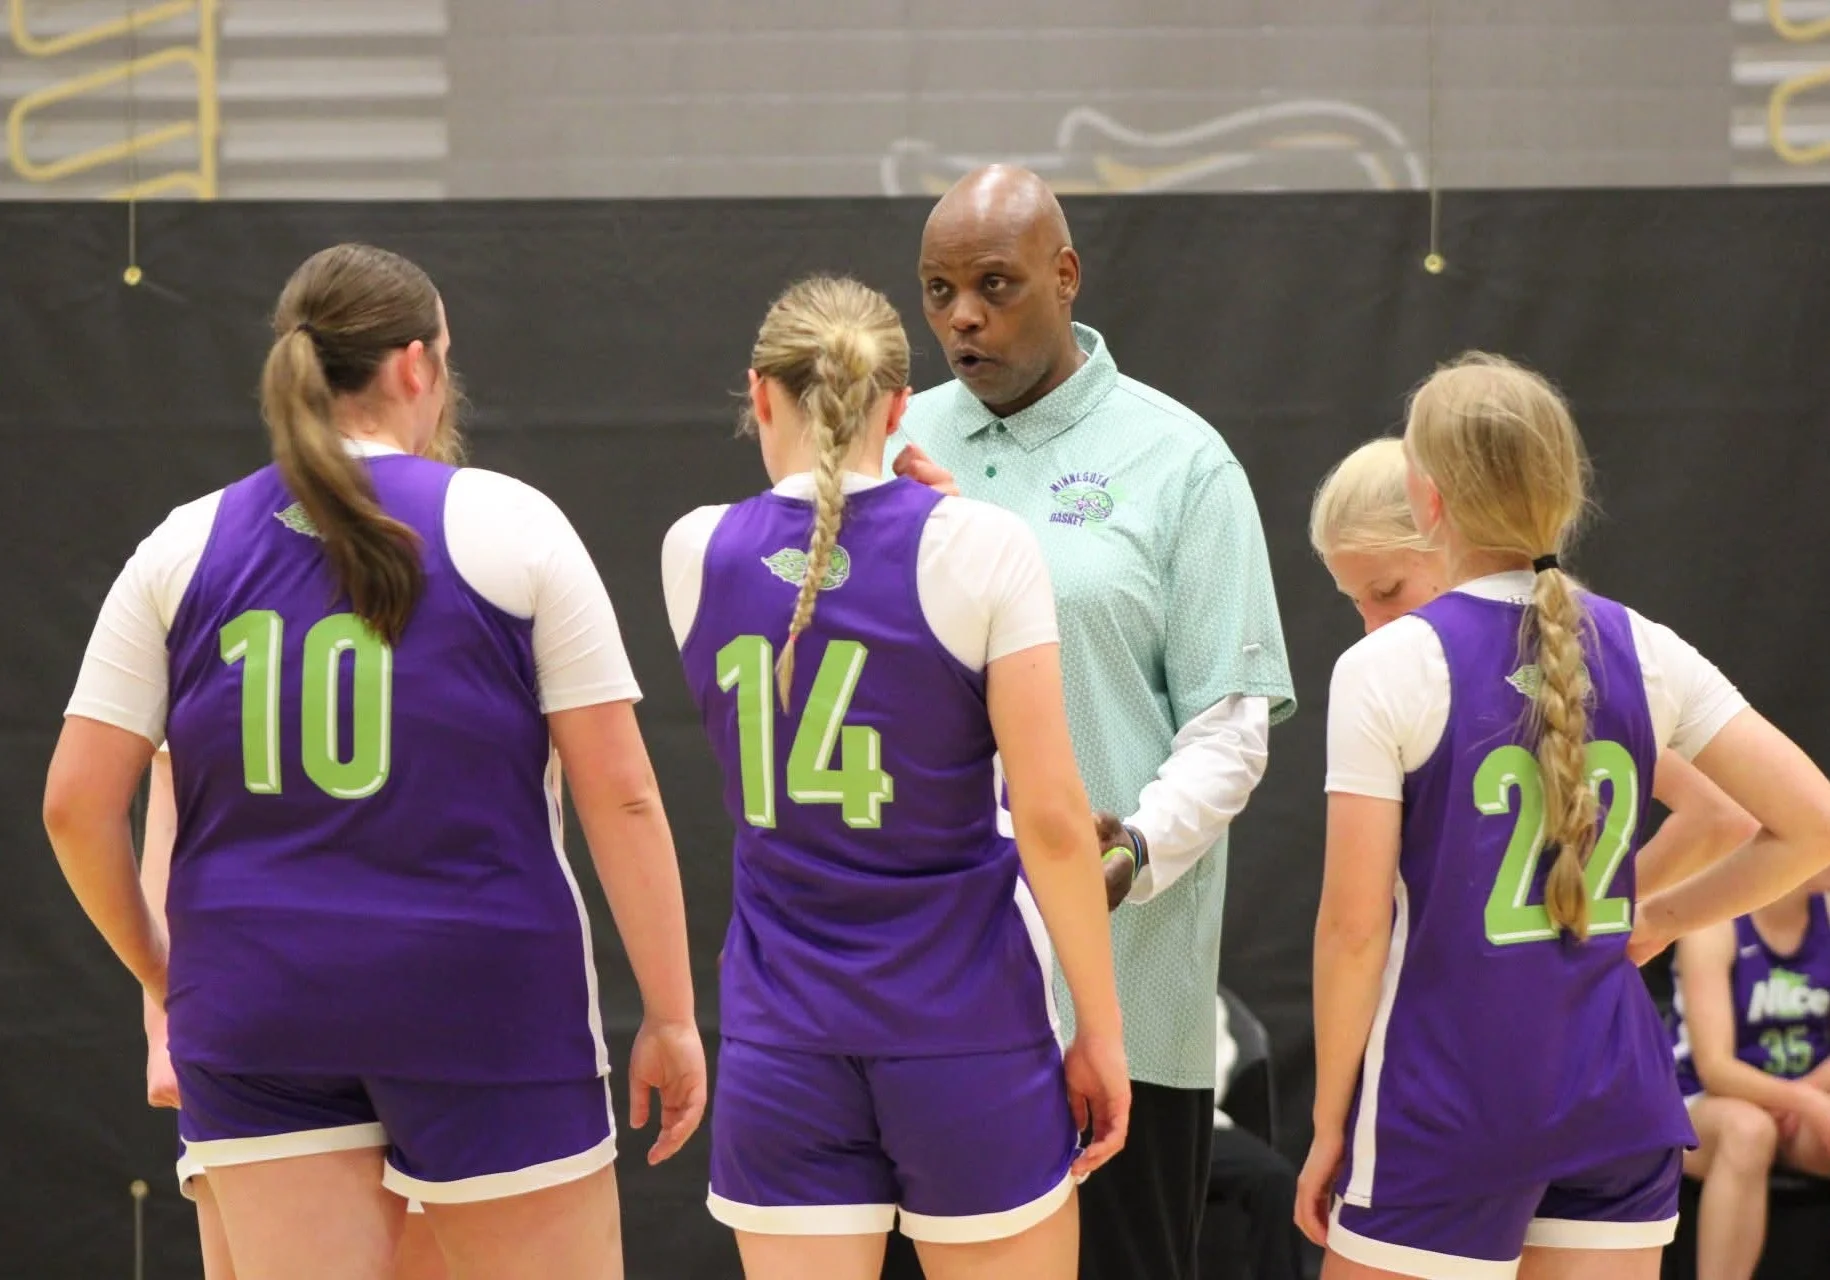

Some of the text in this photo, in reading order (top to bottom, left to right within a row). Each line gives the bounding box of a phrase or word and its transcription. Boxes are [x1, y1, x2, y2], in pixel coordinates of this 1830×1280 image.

[219, 609, 393, 799] 10
[716, 634, 893, 828] 14
[1473, 740, 1638, 945] 22
[1759, 1025, 1813, 1075] 35
